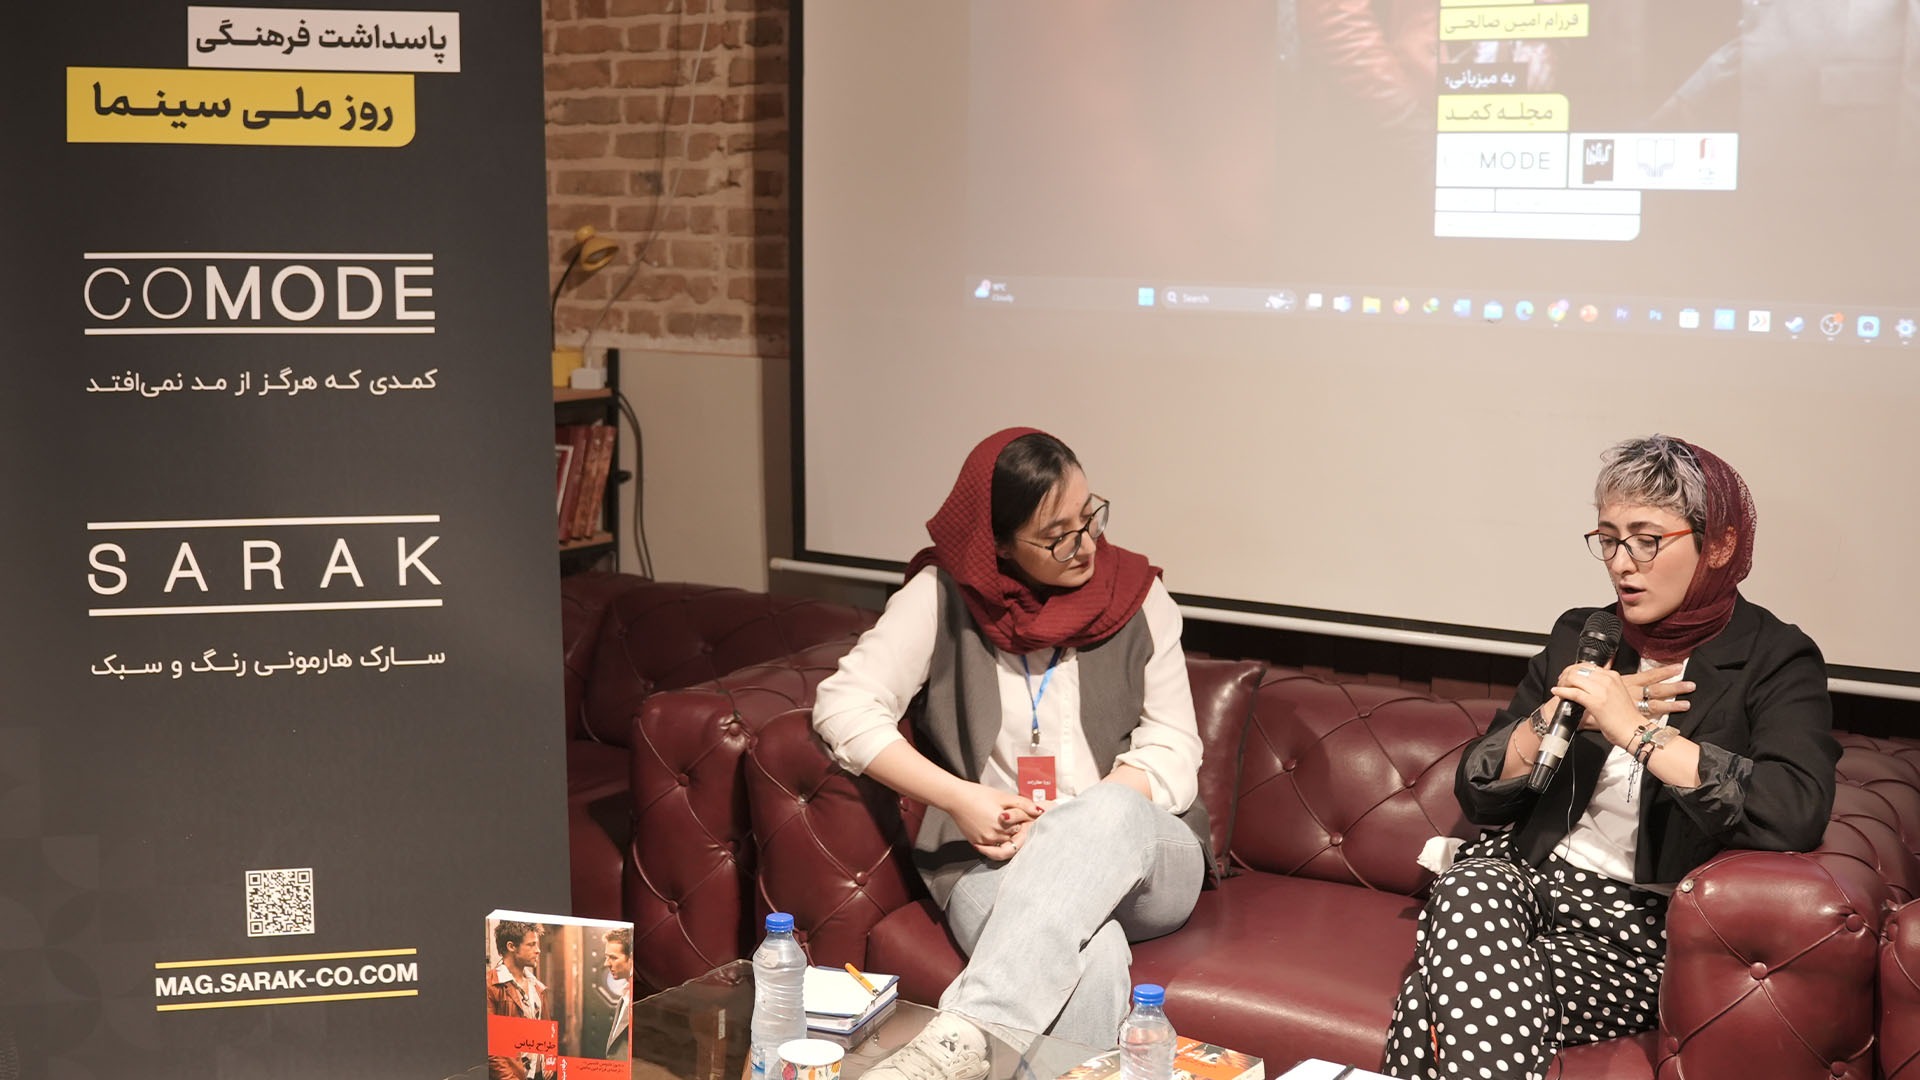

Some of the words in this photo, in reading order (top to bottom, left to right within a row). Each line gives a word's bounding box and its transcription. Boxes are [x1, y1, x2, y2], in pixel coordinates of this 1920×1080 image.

[196, 19, 311, 55] فرهنگی
[318, 23, 447, 64] پاسداشت
[1500, 71, 1516, 88] به
[92, 81, 232, 129] سینما
[242, 86, 332, 130] ملی
[340, 94, 394, 132] روز
[1445, 103, 1492, 121] کمد
[1497, 102, 1553, 126] مجله
[84, 264, 436, 322] COMODE
[190, 374, 227, 391] مد
[234, 371, 251, 396] از
[258, 366, 318, 396] هرگز
[324, 369, 362, 390] که
[369, 368, 438, 396] کمدی
[87, 535, 442, 595] SARAK
[91, 654, 163, 681] سبک
[171, 660, 183, 679] و
[190, 648, 247, 677] رنگ
[254, 648, 353, 677] هارمونی
[359, 645, 446, 672] سارک
[155, 963, 419, 998] MAG.SARAK-CO.COM
[514, 1039, 535, 1050] لباس
[535, 1041, 556, 1052] طراح
